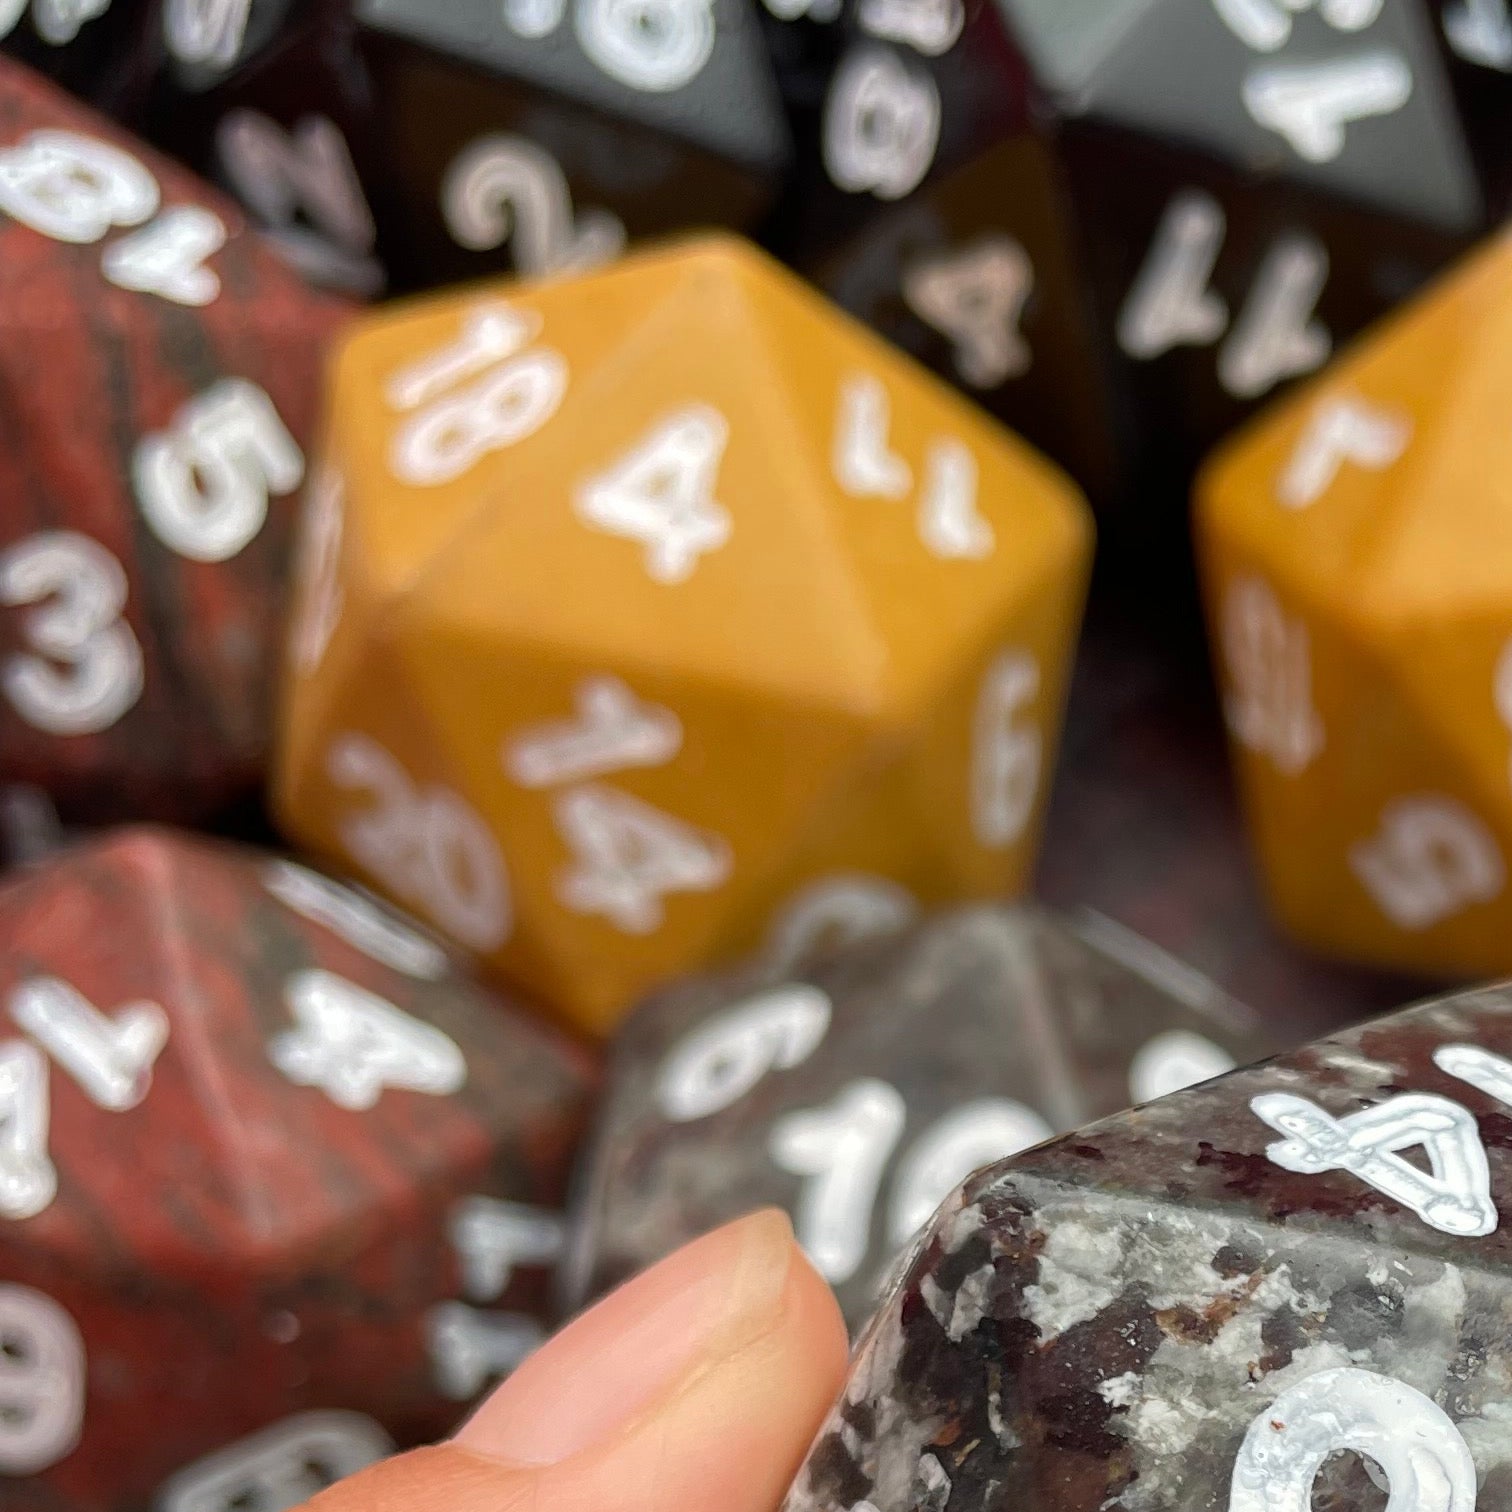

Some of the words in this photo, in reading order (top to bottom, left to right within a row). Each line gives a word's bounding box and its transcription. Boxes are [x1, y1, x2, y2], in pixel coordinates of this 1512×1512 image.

[387, 303, 568, 487] 18
[833, 374, 997, 561] 11
[574, 404, 733, 585] 4
[508, 673, 735, 935] 14
[267, 969, 467, 1110] 4
